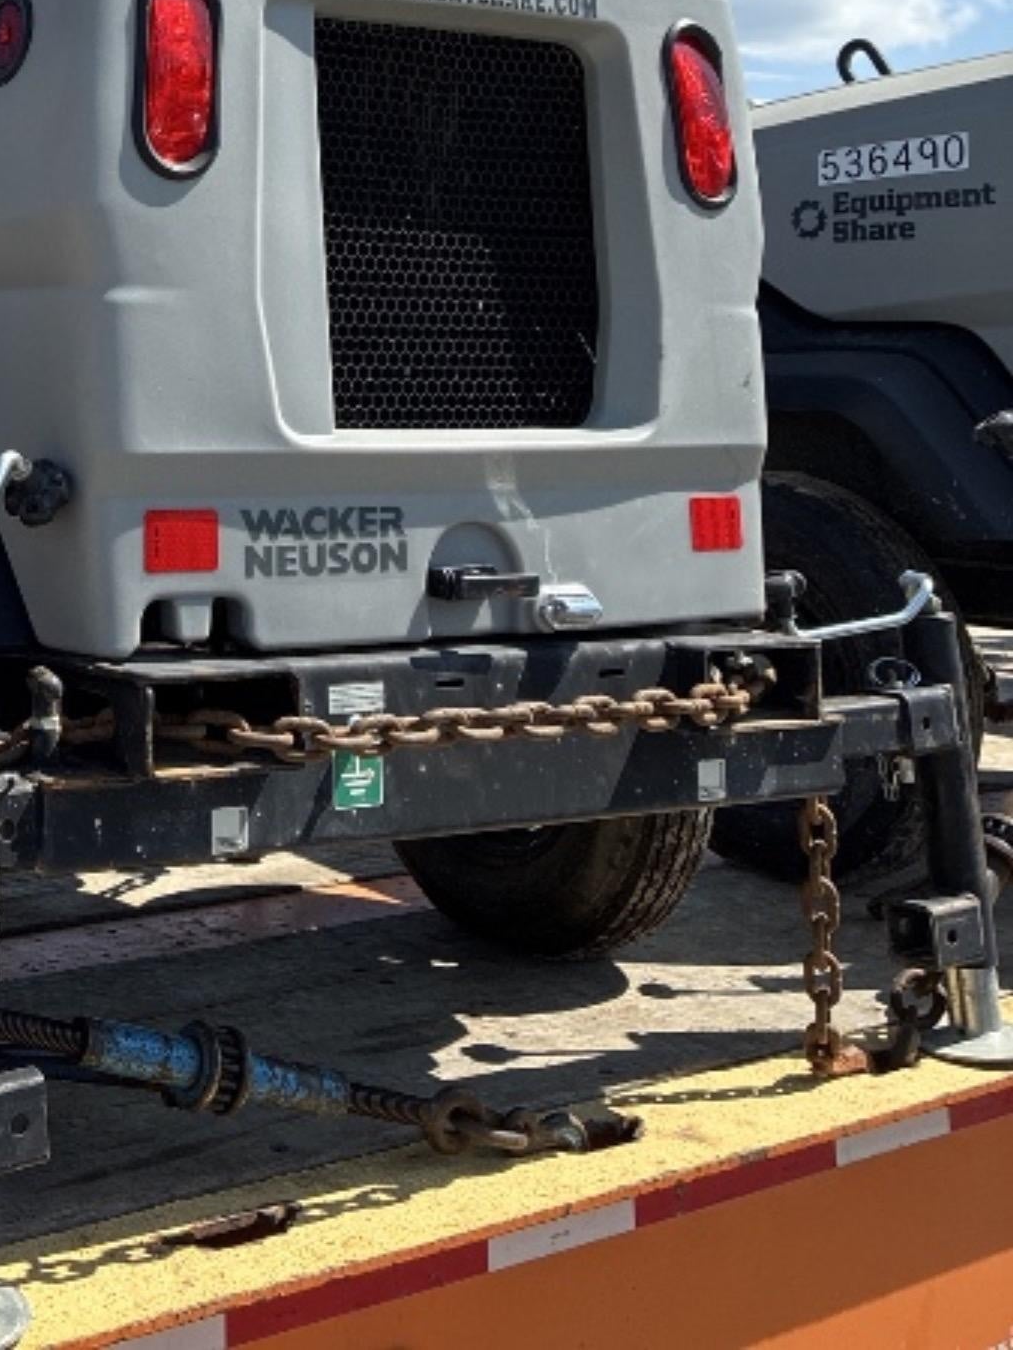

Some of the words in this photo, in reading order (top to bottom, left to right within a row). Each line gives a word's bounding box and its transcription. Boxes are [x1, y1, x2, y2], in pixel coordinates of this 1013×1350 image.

[820, 134, 965, 181] 536490
[832, 182, 996, 218] Equipment
[832, 220, 916, 243] Share
[238, 506, 405, 541] WACKER
[244, 539, 408, 578] NEUSON
